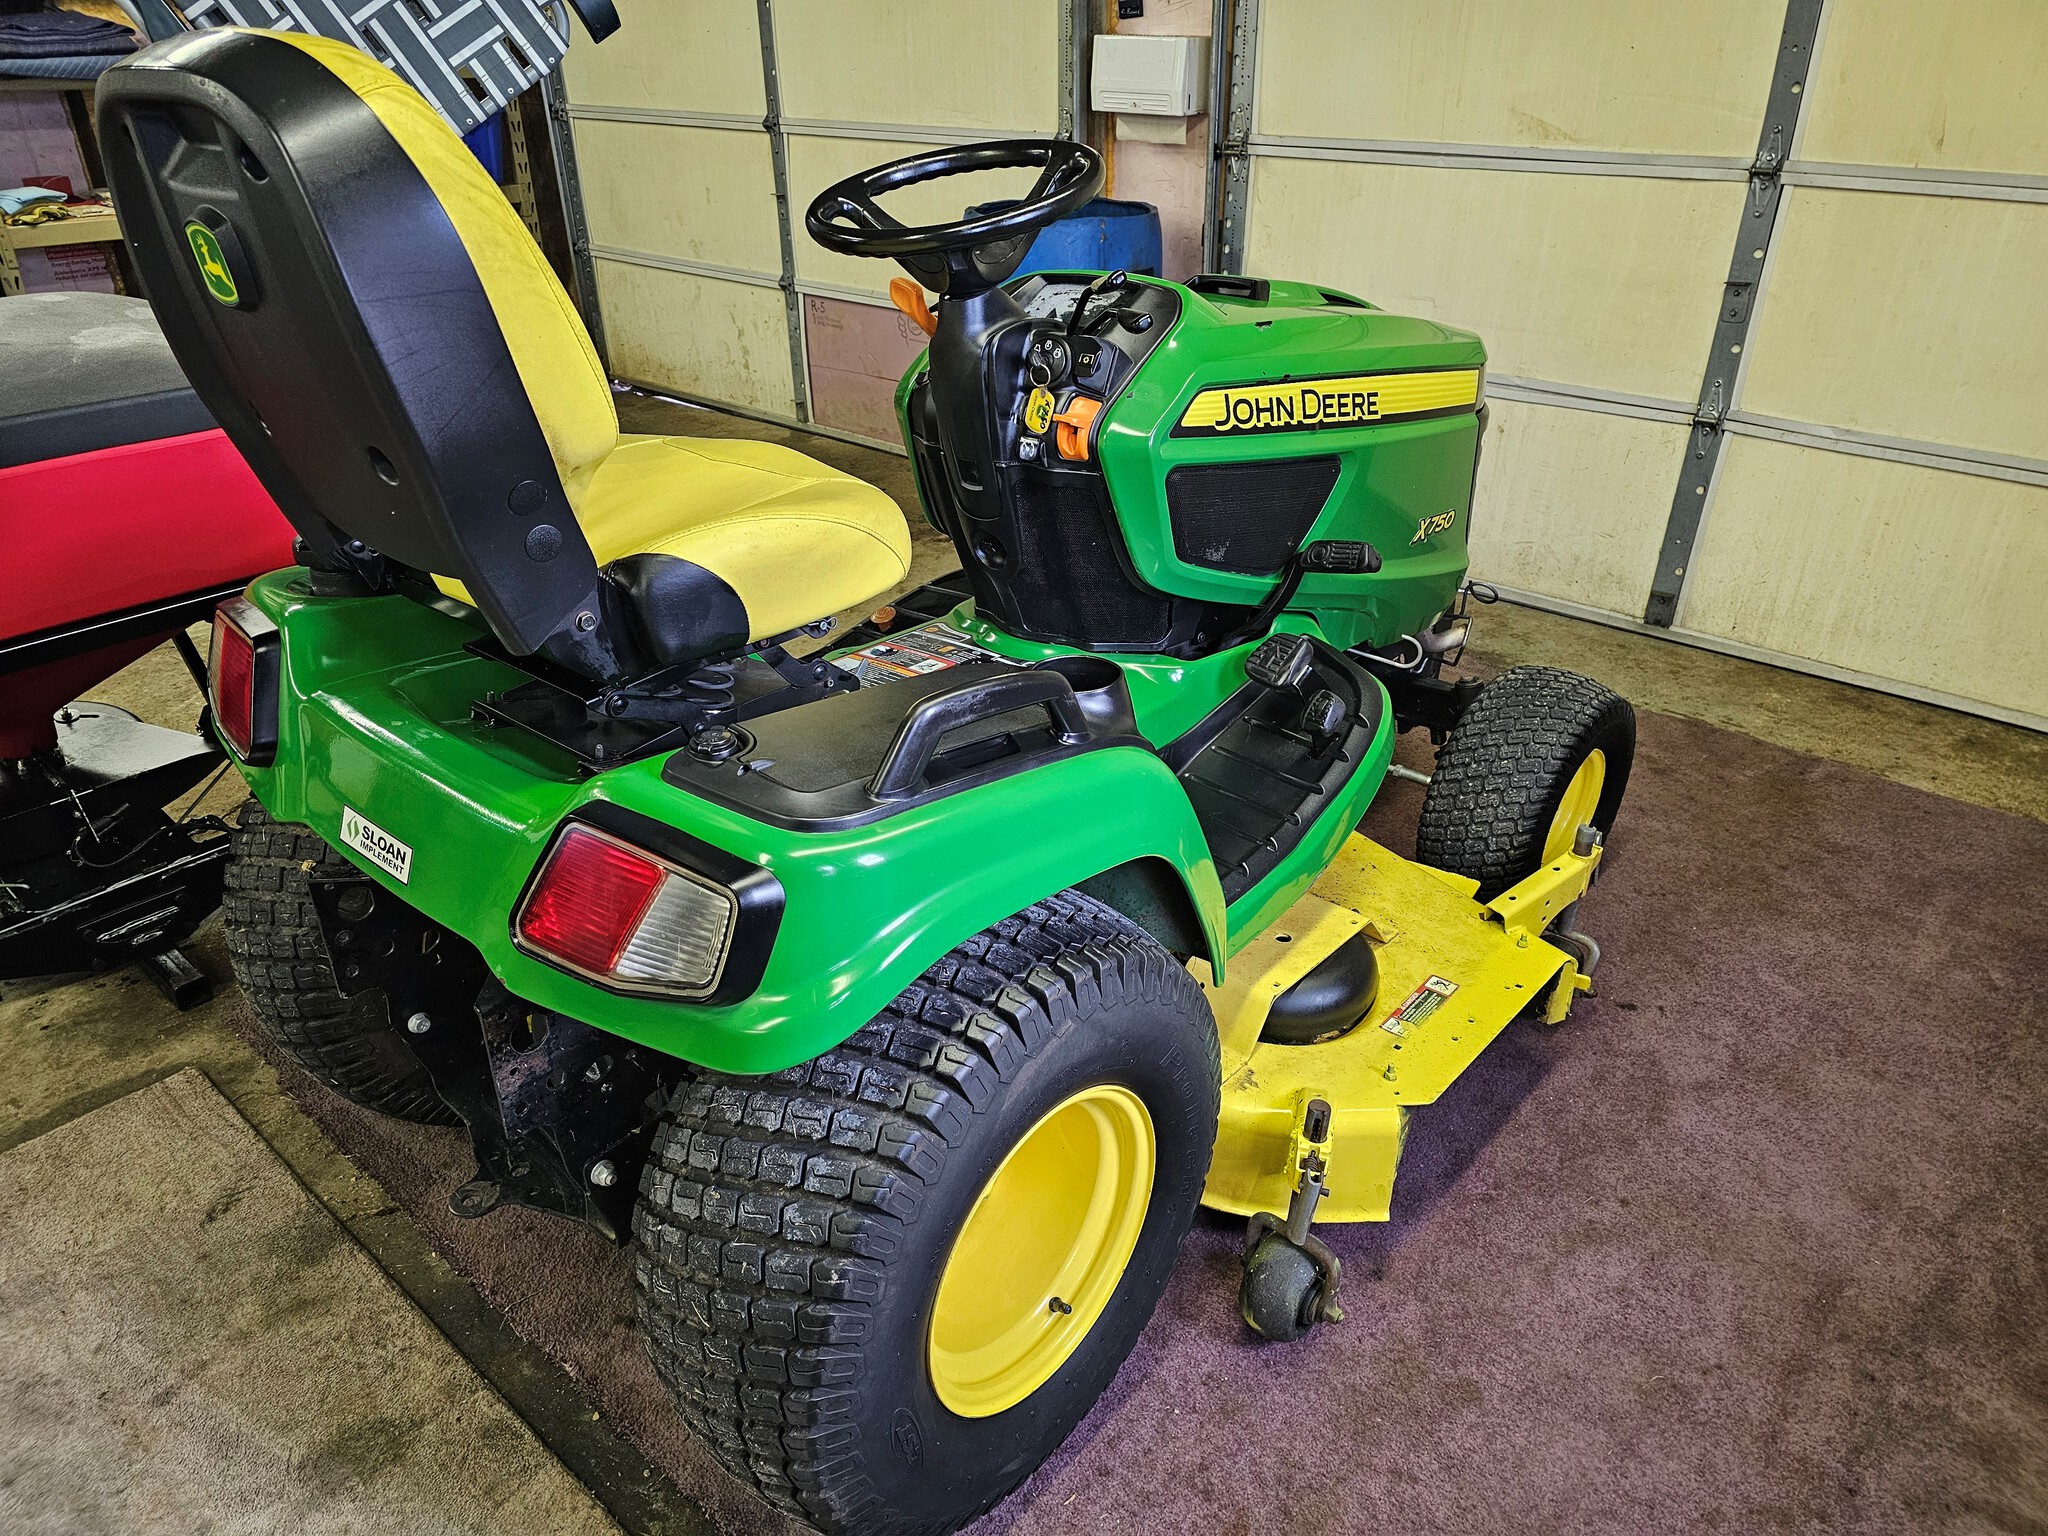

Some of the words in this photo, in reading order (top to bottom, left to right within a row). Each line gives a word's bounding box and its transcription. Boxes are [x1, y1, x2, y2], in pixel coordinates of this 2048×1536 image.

[810, 300, 826, 313] R-5
[1215, 393, 1294, 428] JOHN
[1301, 389, 1380, 422] DEERE
[1410, 509, 1456, 544] X750
[360, 839, 404, 875] IMPLEMENT
[361, 825, 407, 865] SLOAN
